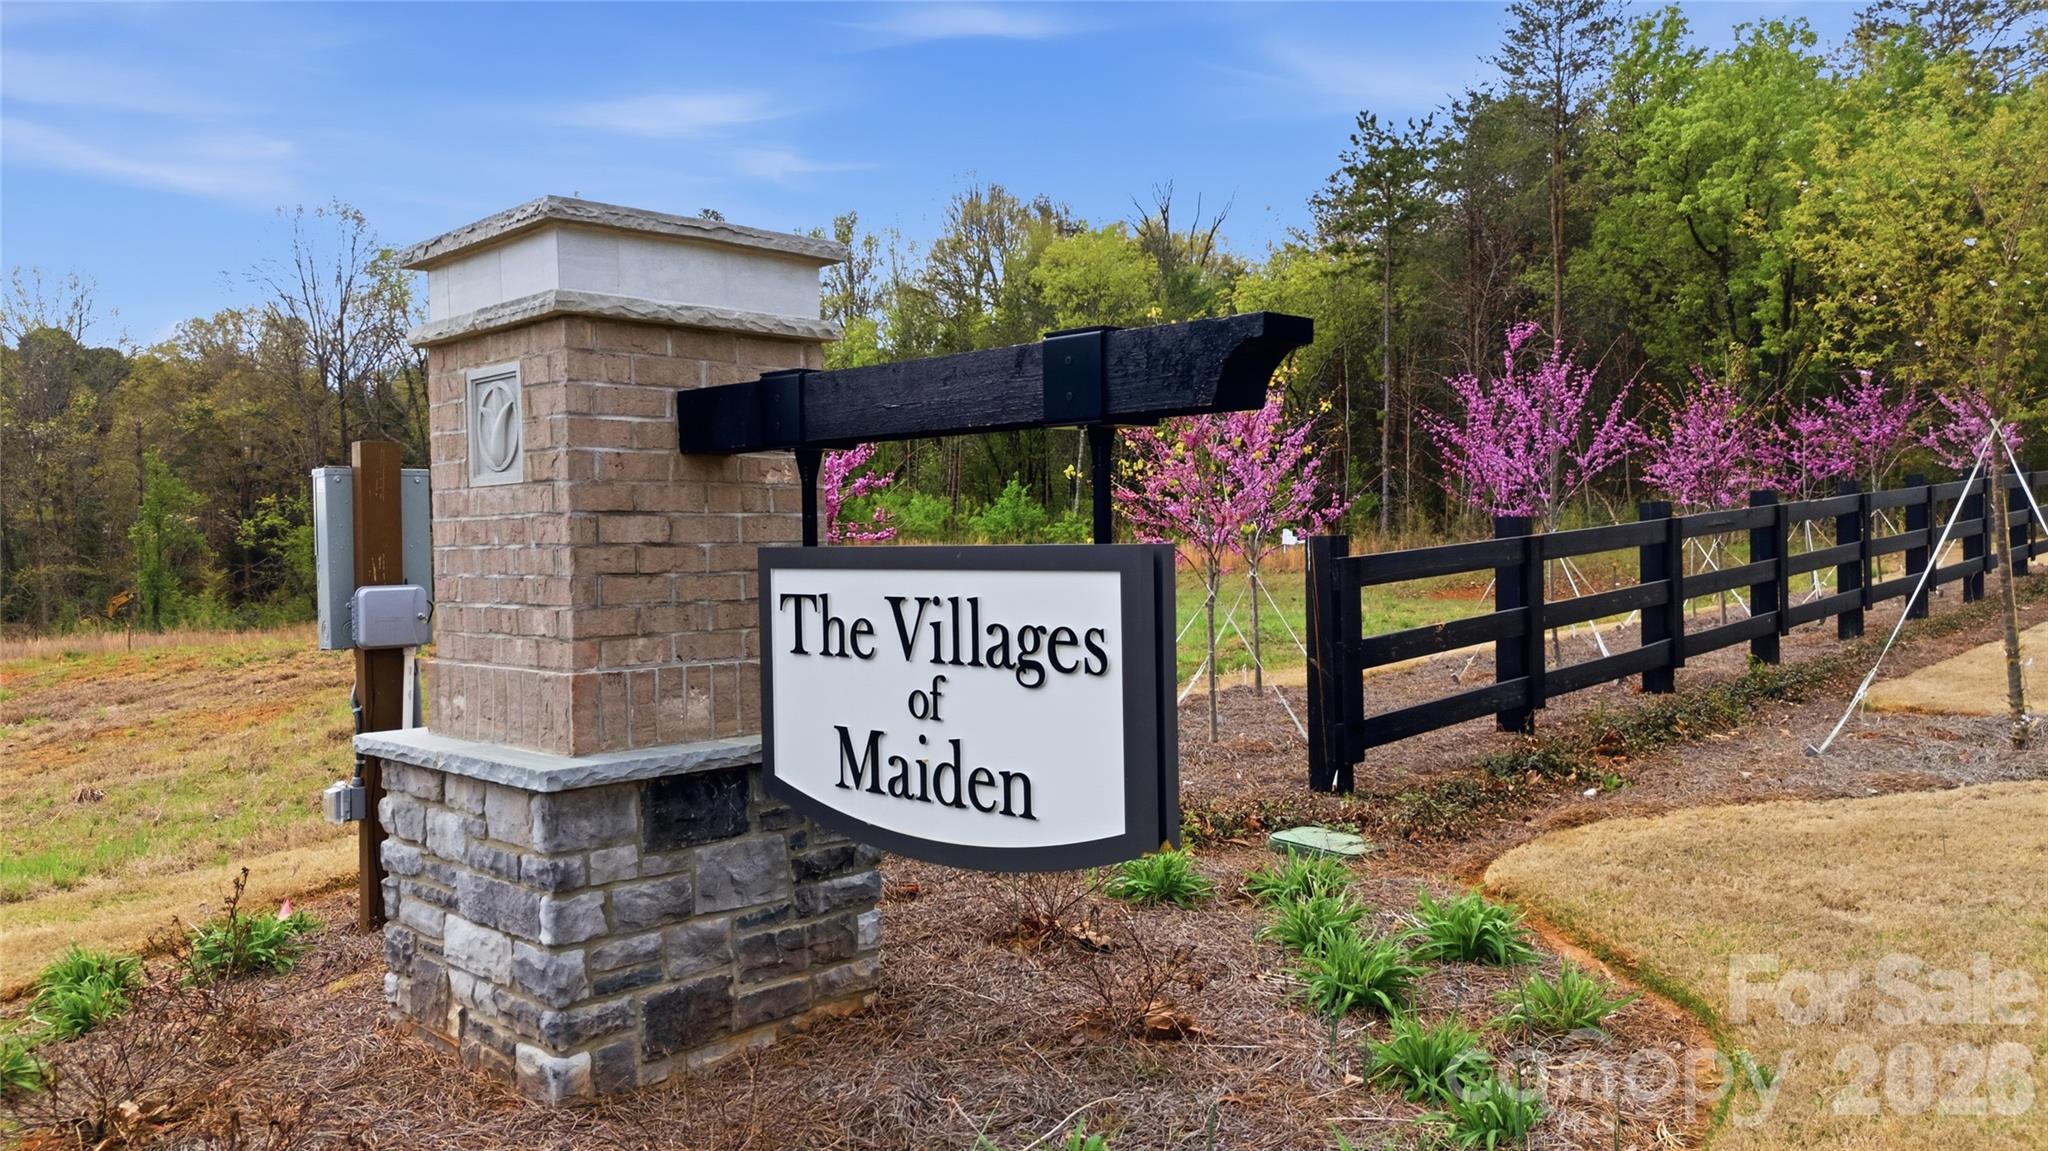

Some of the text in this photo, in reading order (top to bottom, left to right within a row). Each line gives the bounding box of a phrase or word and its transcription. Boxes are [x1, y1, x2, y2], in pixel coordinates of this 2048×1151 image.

[780, 593, 1109, 689] The Villages
[908, 675, 947, 722] of
[834, 725, 1039, 822] Maiden
